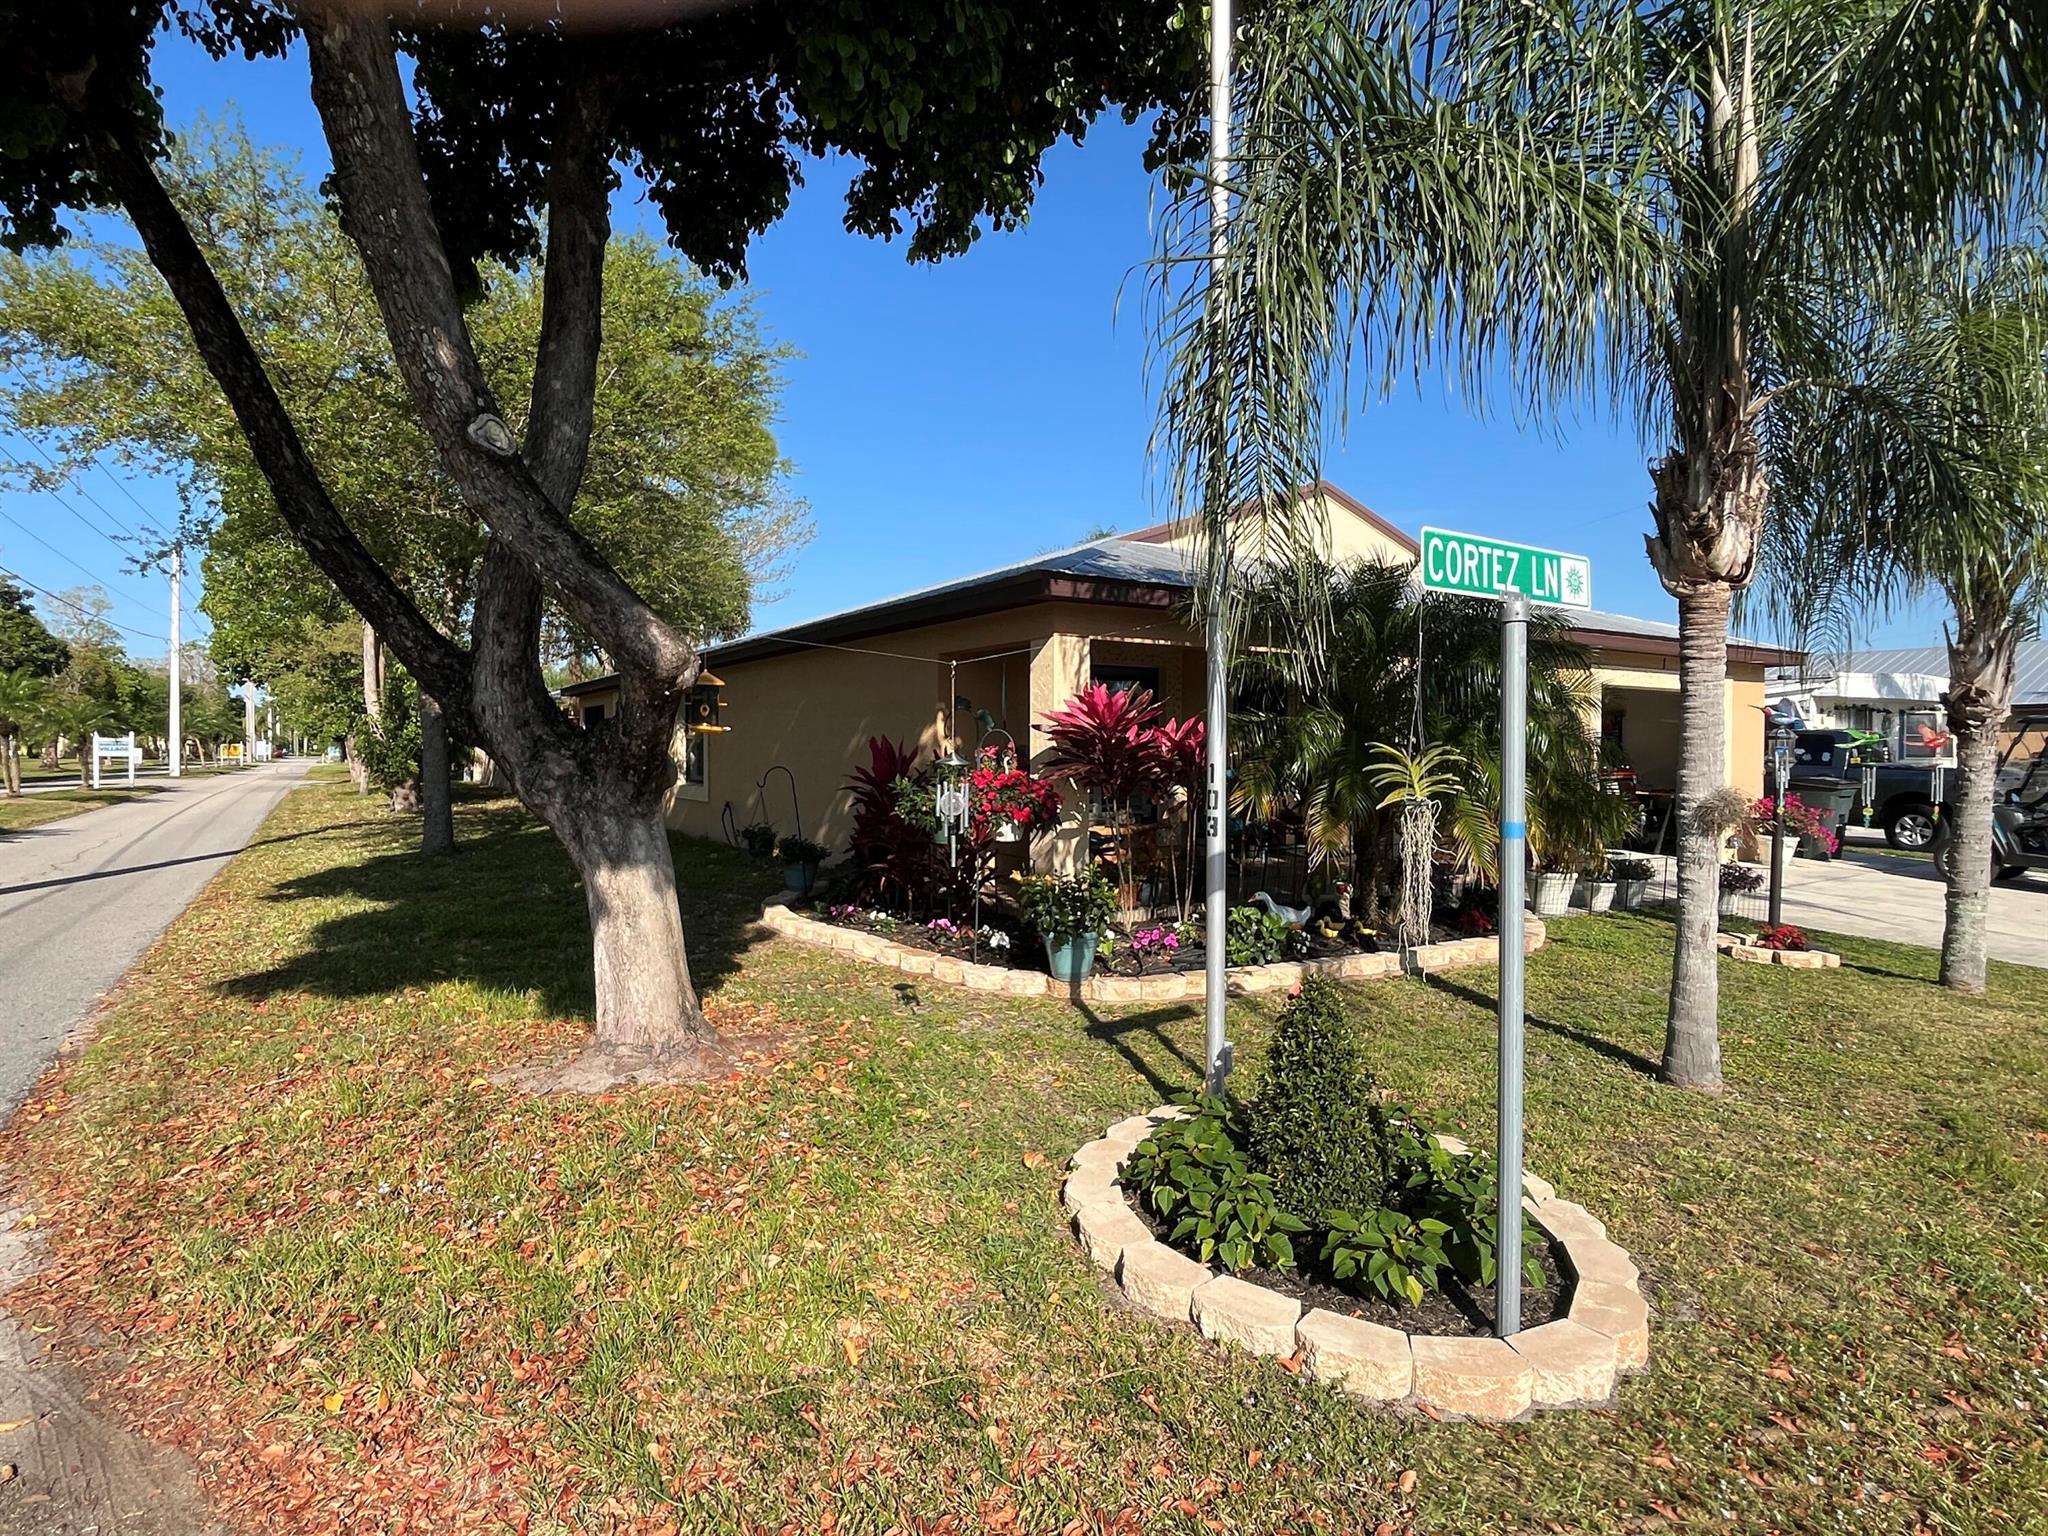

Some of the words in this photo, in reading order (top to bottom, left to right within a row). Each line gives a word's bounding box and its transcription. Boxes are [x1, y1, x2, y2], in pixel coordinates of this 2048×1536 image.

[1428, 537, 1520, 592] CORTEZ
[1532, 555, 1559, 598] LN
[1207, 763, 1219, 838] 103
